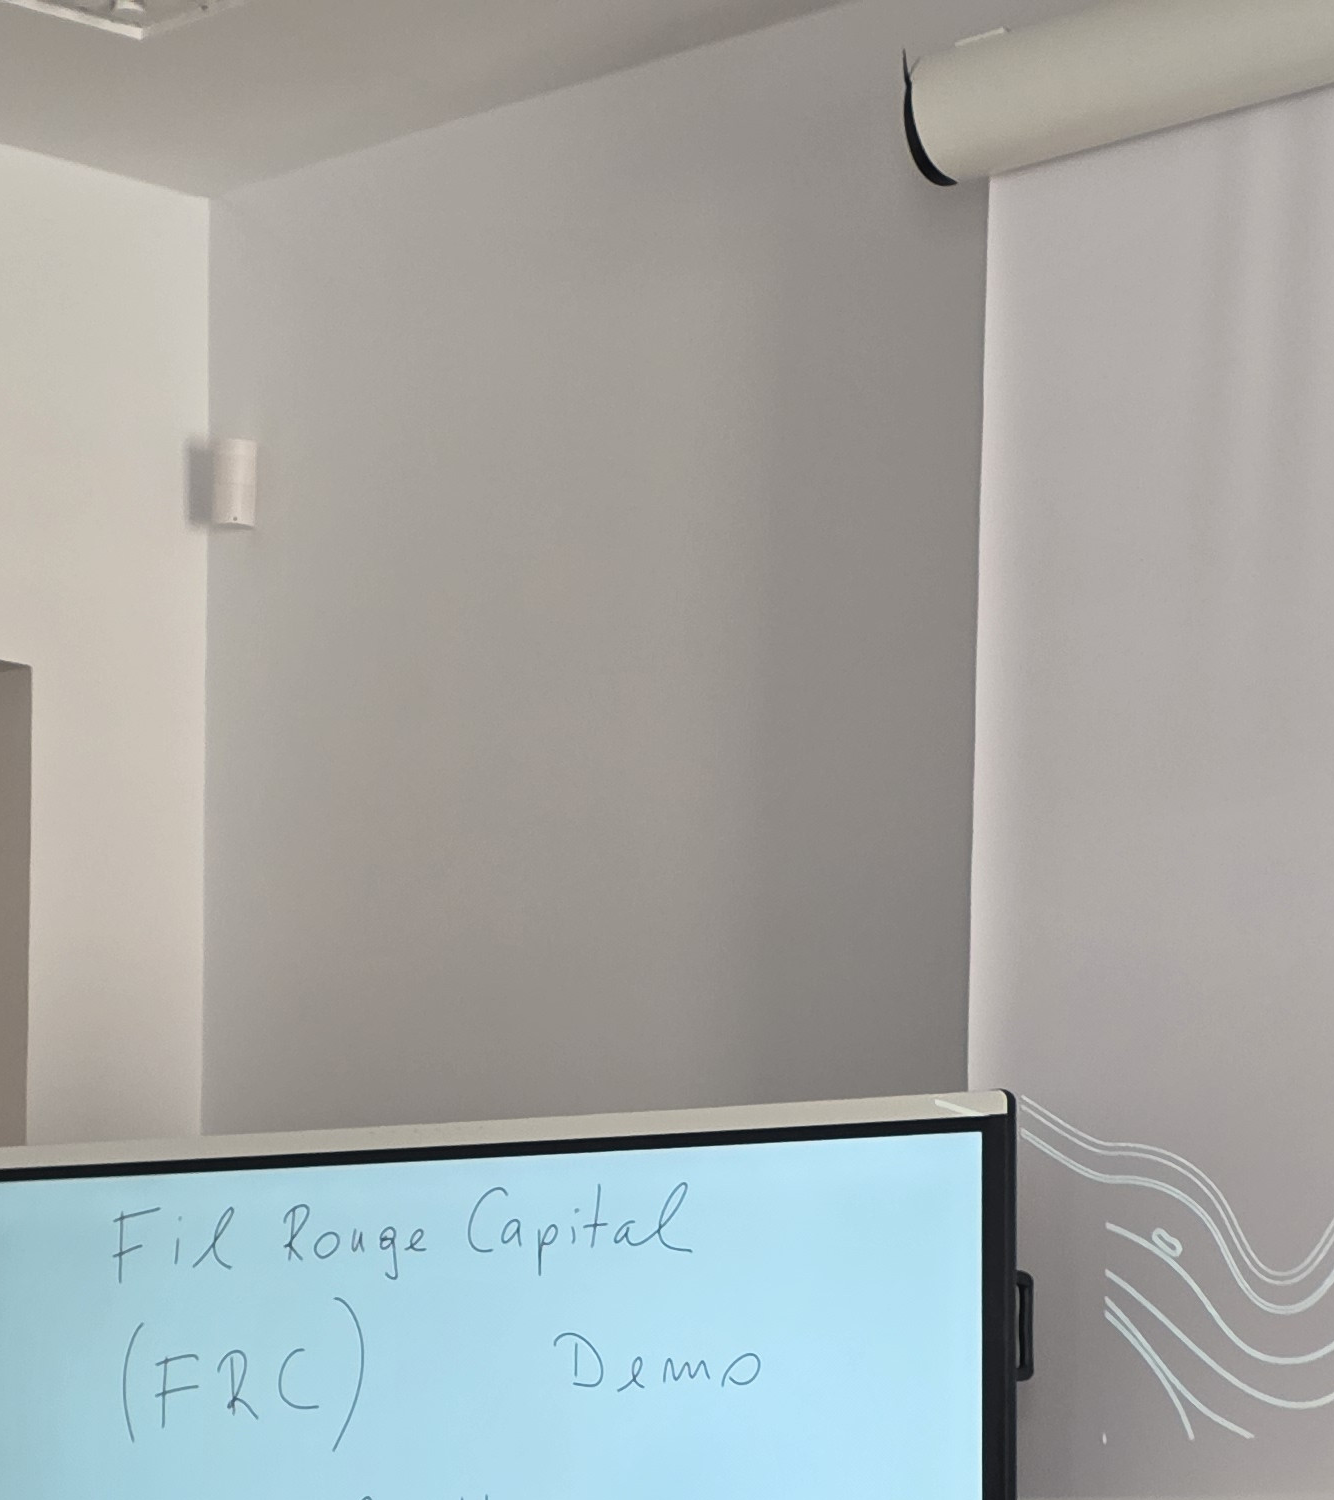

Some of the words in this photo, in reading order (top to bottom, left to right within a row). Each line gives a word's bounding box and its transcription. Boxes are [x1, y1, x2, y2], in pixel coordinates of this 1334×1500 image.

[113, 1206, 236, 1284] Fil
[283, 1203, 428, 1281] Rouge
[466, 1181, 693, 1277] Capital
[122, 1296, 365, 1453] (FRC)
[553, 1331, 763, 1393] Demo
